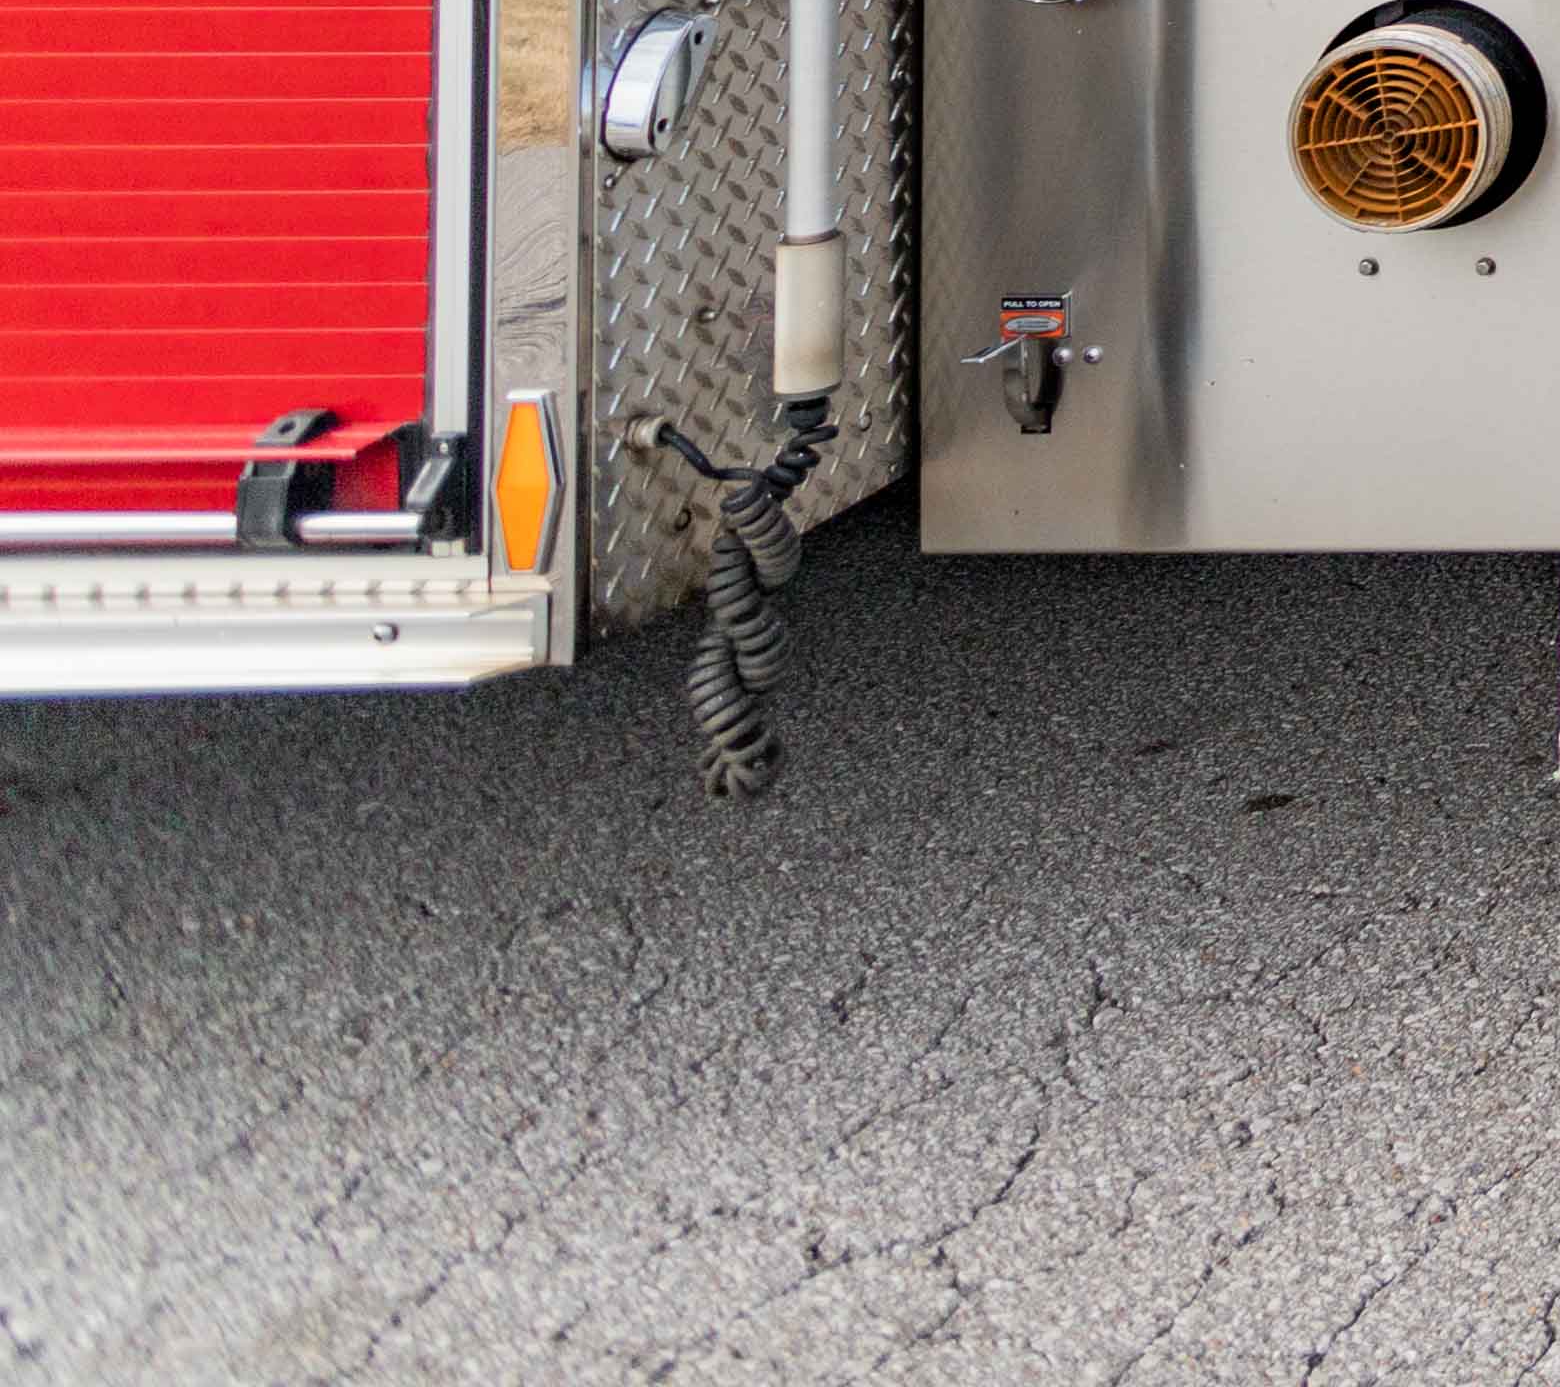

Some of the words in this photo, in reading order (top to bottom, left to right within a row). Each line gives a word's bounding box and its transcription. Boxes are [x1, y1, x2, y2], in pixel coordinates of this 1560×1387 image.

[1003, 300, 1025, 308] PULL
[1026, 300, 1038, 308] TO
[1038, 300, 1061, 308] OPEN
